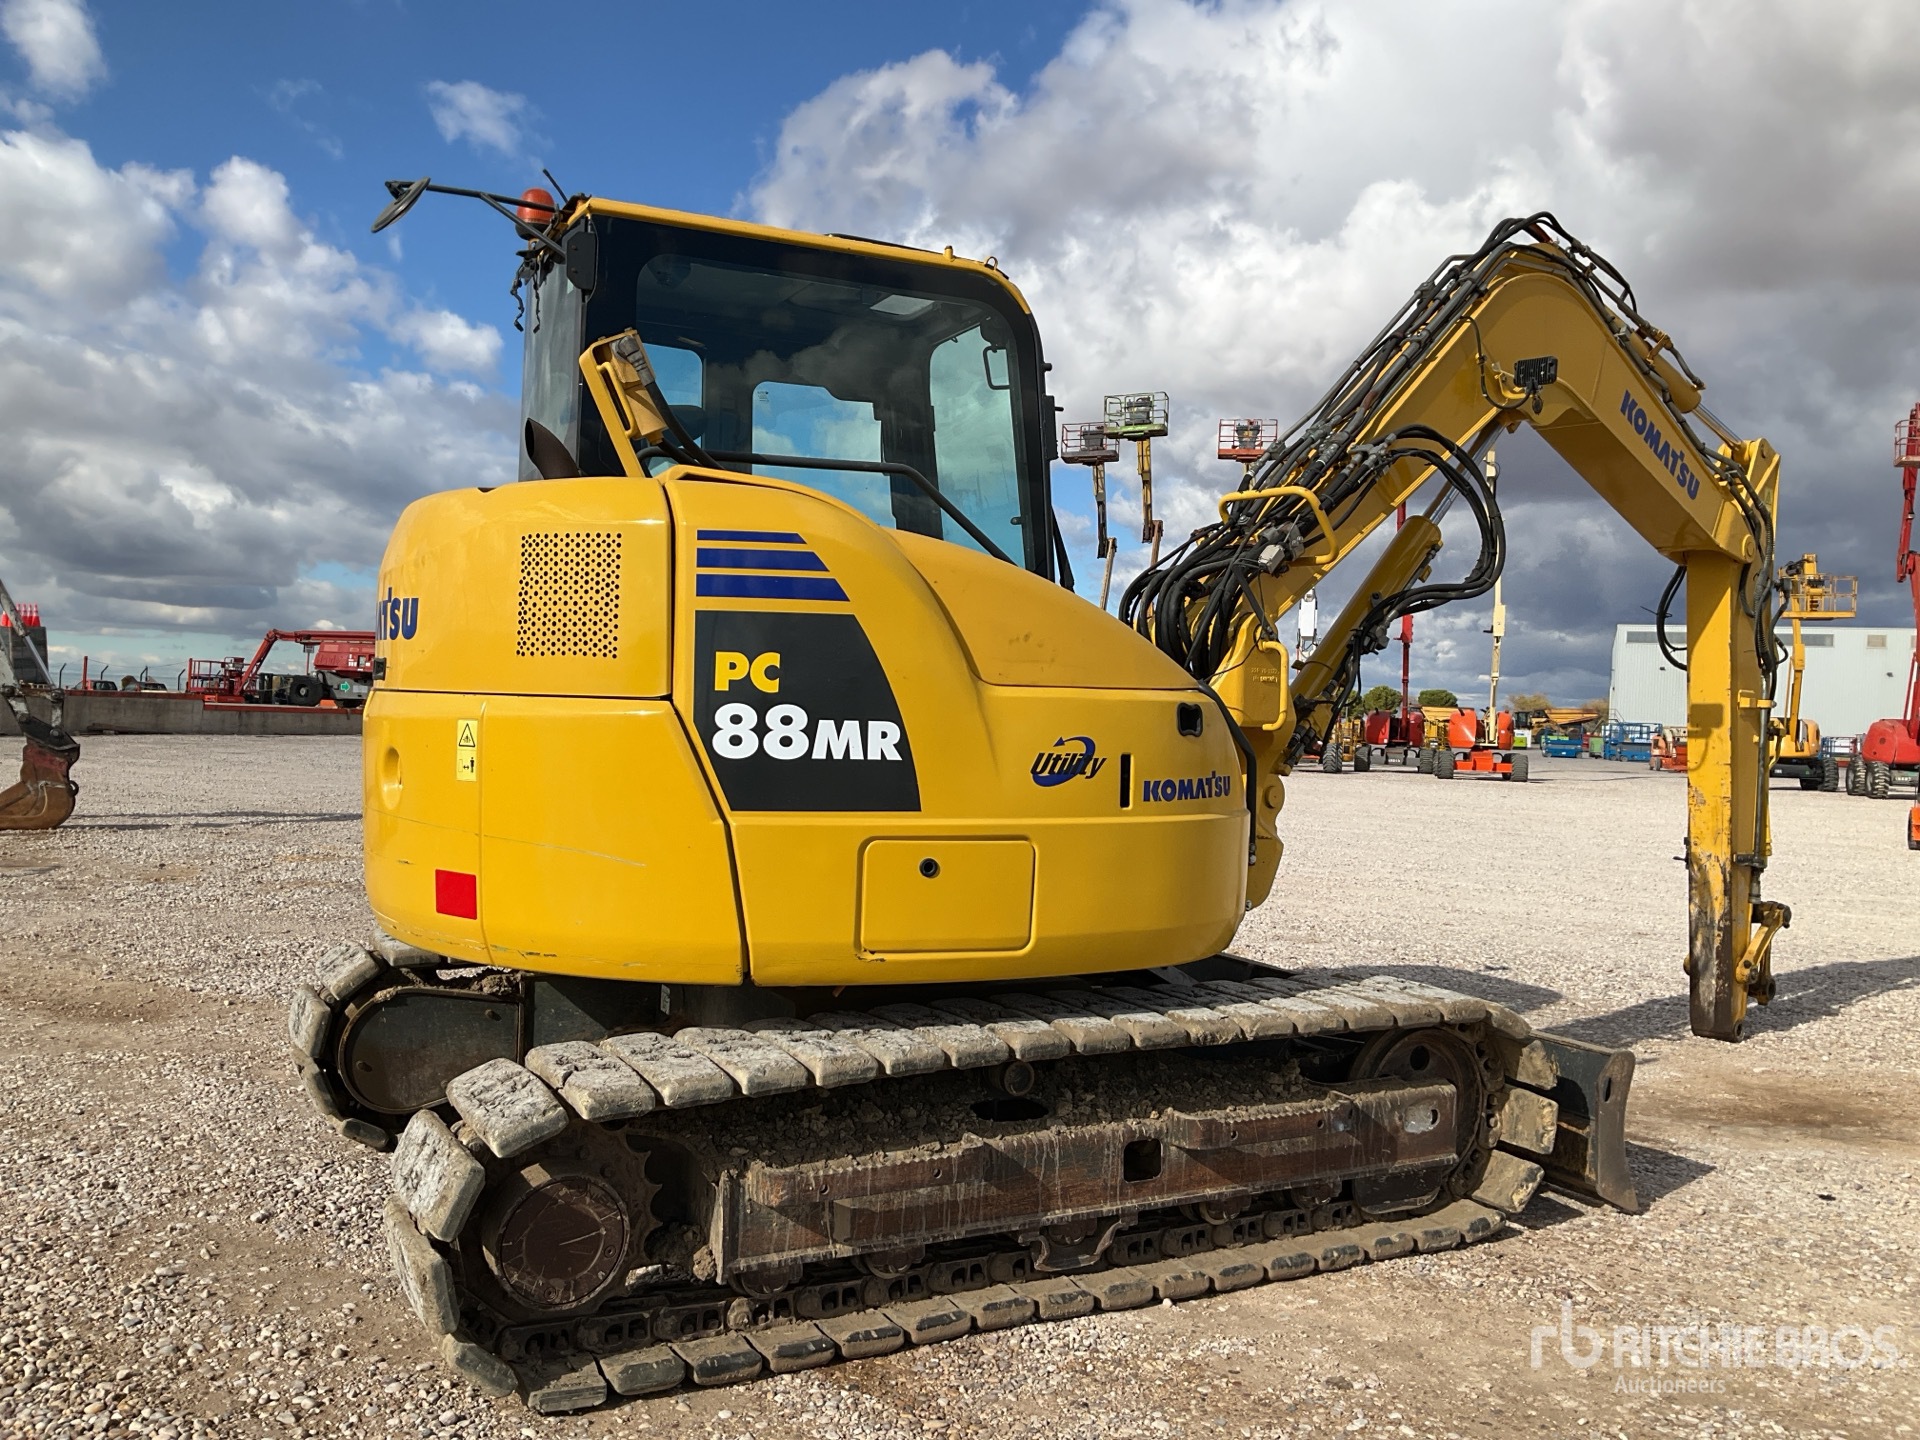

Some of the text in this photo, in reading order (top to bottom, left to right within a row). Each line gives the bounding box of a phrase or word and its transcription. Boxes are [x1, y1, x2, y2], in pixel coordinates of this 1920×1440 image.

[1620, 389, 1700, 500] KOMATSU
[714, 651, 781, 693] PC
[712, 703, 902, 762] 88MR
[1030, 752, 1107, 779] Utility
[1143, 770, 1231, 802] KOMATSU
